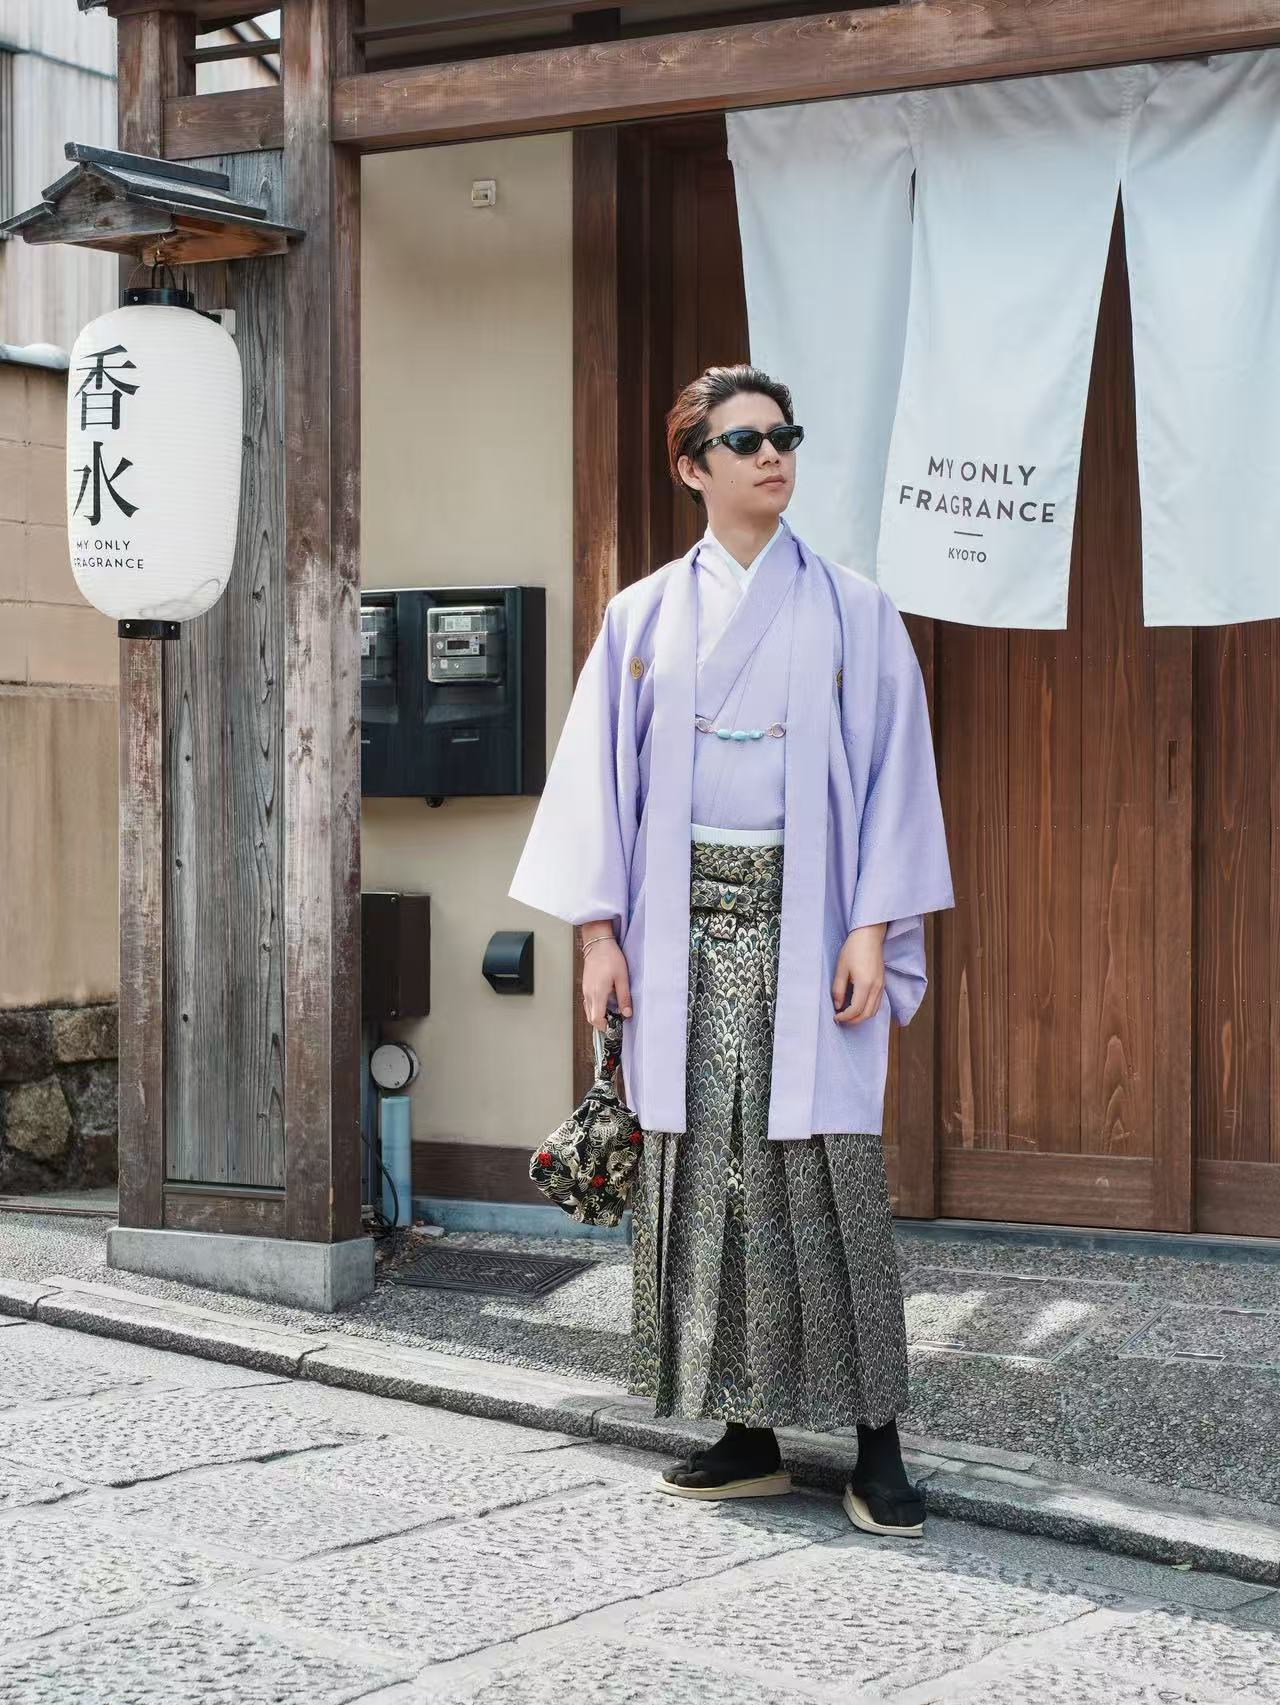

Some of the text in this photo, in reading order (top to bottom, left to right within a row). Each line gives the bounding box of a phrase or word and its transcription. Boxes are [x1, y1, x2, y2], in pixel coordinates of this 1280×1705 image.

[74, 344, 140, 526] 香水
[927, 456, 1036, 486] MY ONLY
[899, 485, 1056, 523] FRAGRANCE
[76, 539, 130, 551] MY ONLY
[948, 547, 987, 563] KYOTO
